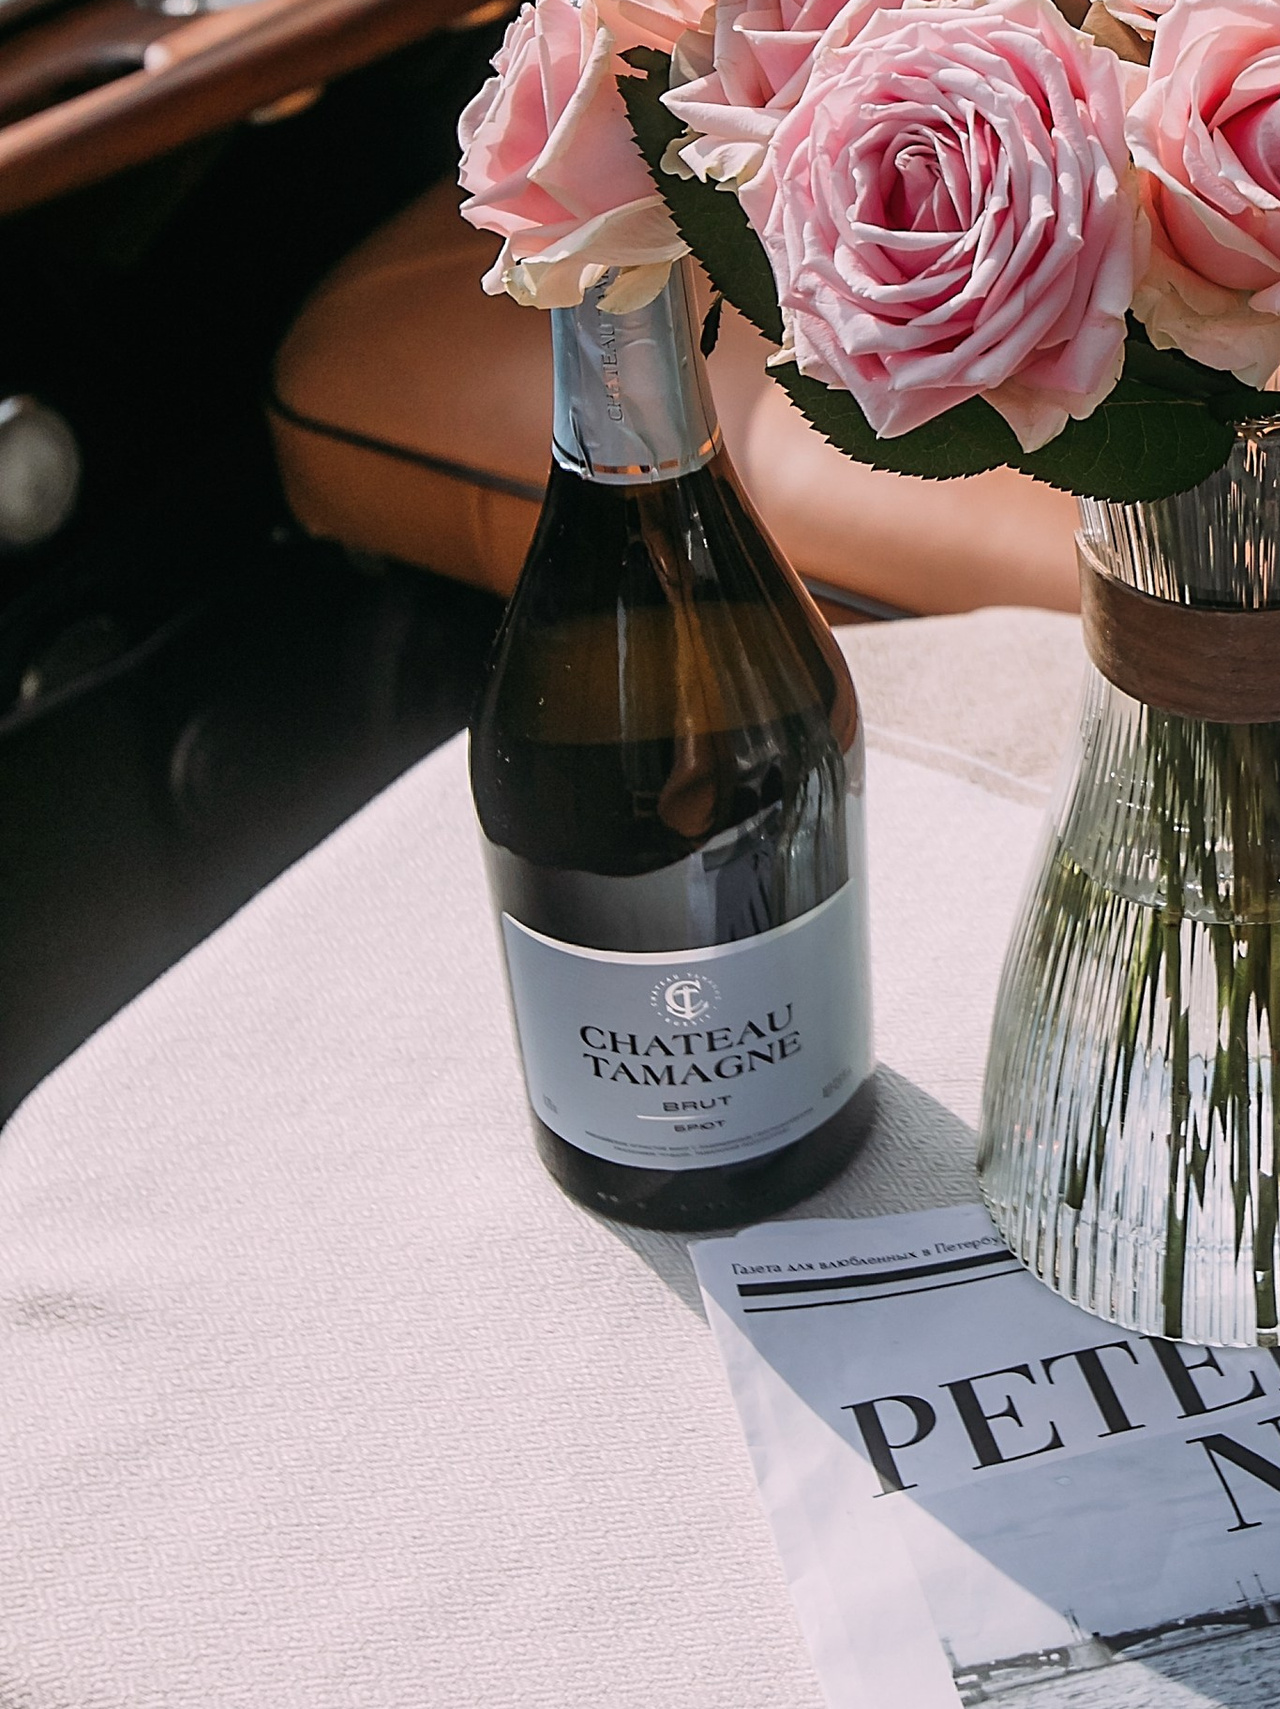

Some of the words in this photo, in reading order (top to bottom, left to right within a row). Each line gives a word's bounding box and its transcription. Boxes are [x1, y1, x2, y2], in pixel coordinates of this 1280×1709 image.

[599, 323, 624, 422] CHATEAU
[579, 1003, 796, 1057] CHATEAU
[582, 1030, 802, 1087] TAMAGNE
[662, 1095, 733, 1112] BRUT
[731, 1262, 783, 1277] Газета
[787, 1261, 815, 1274] для
[818, 1250, 918, 1272] влюбленных
[922, 1248, 931, 1257] в
